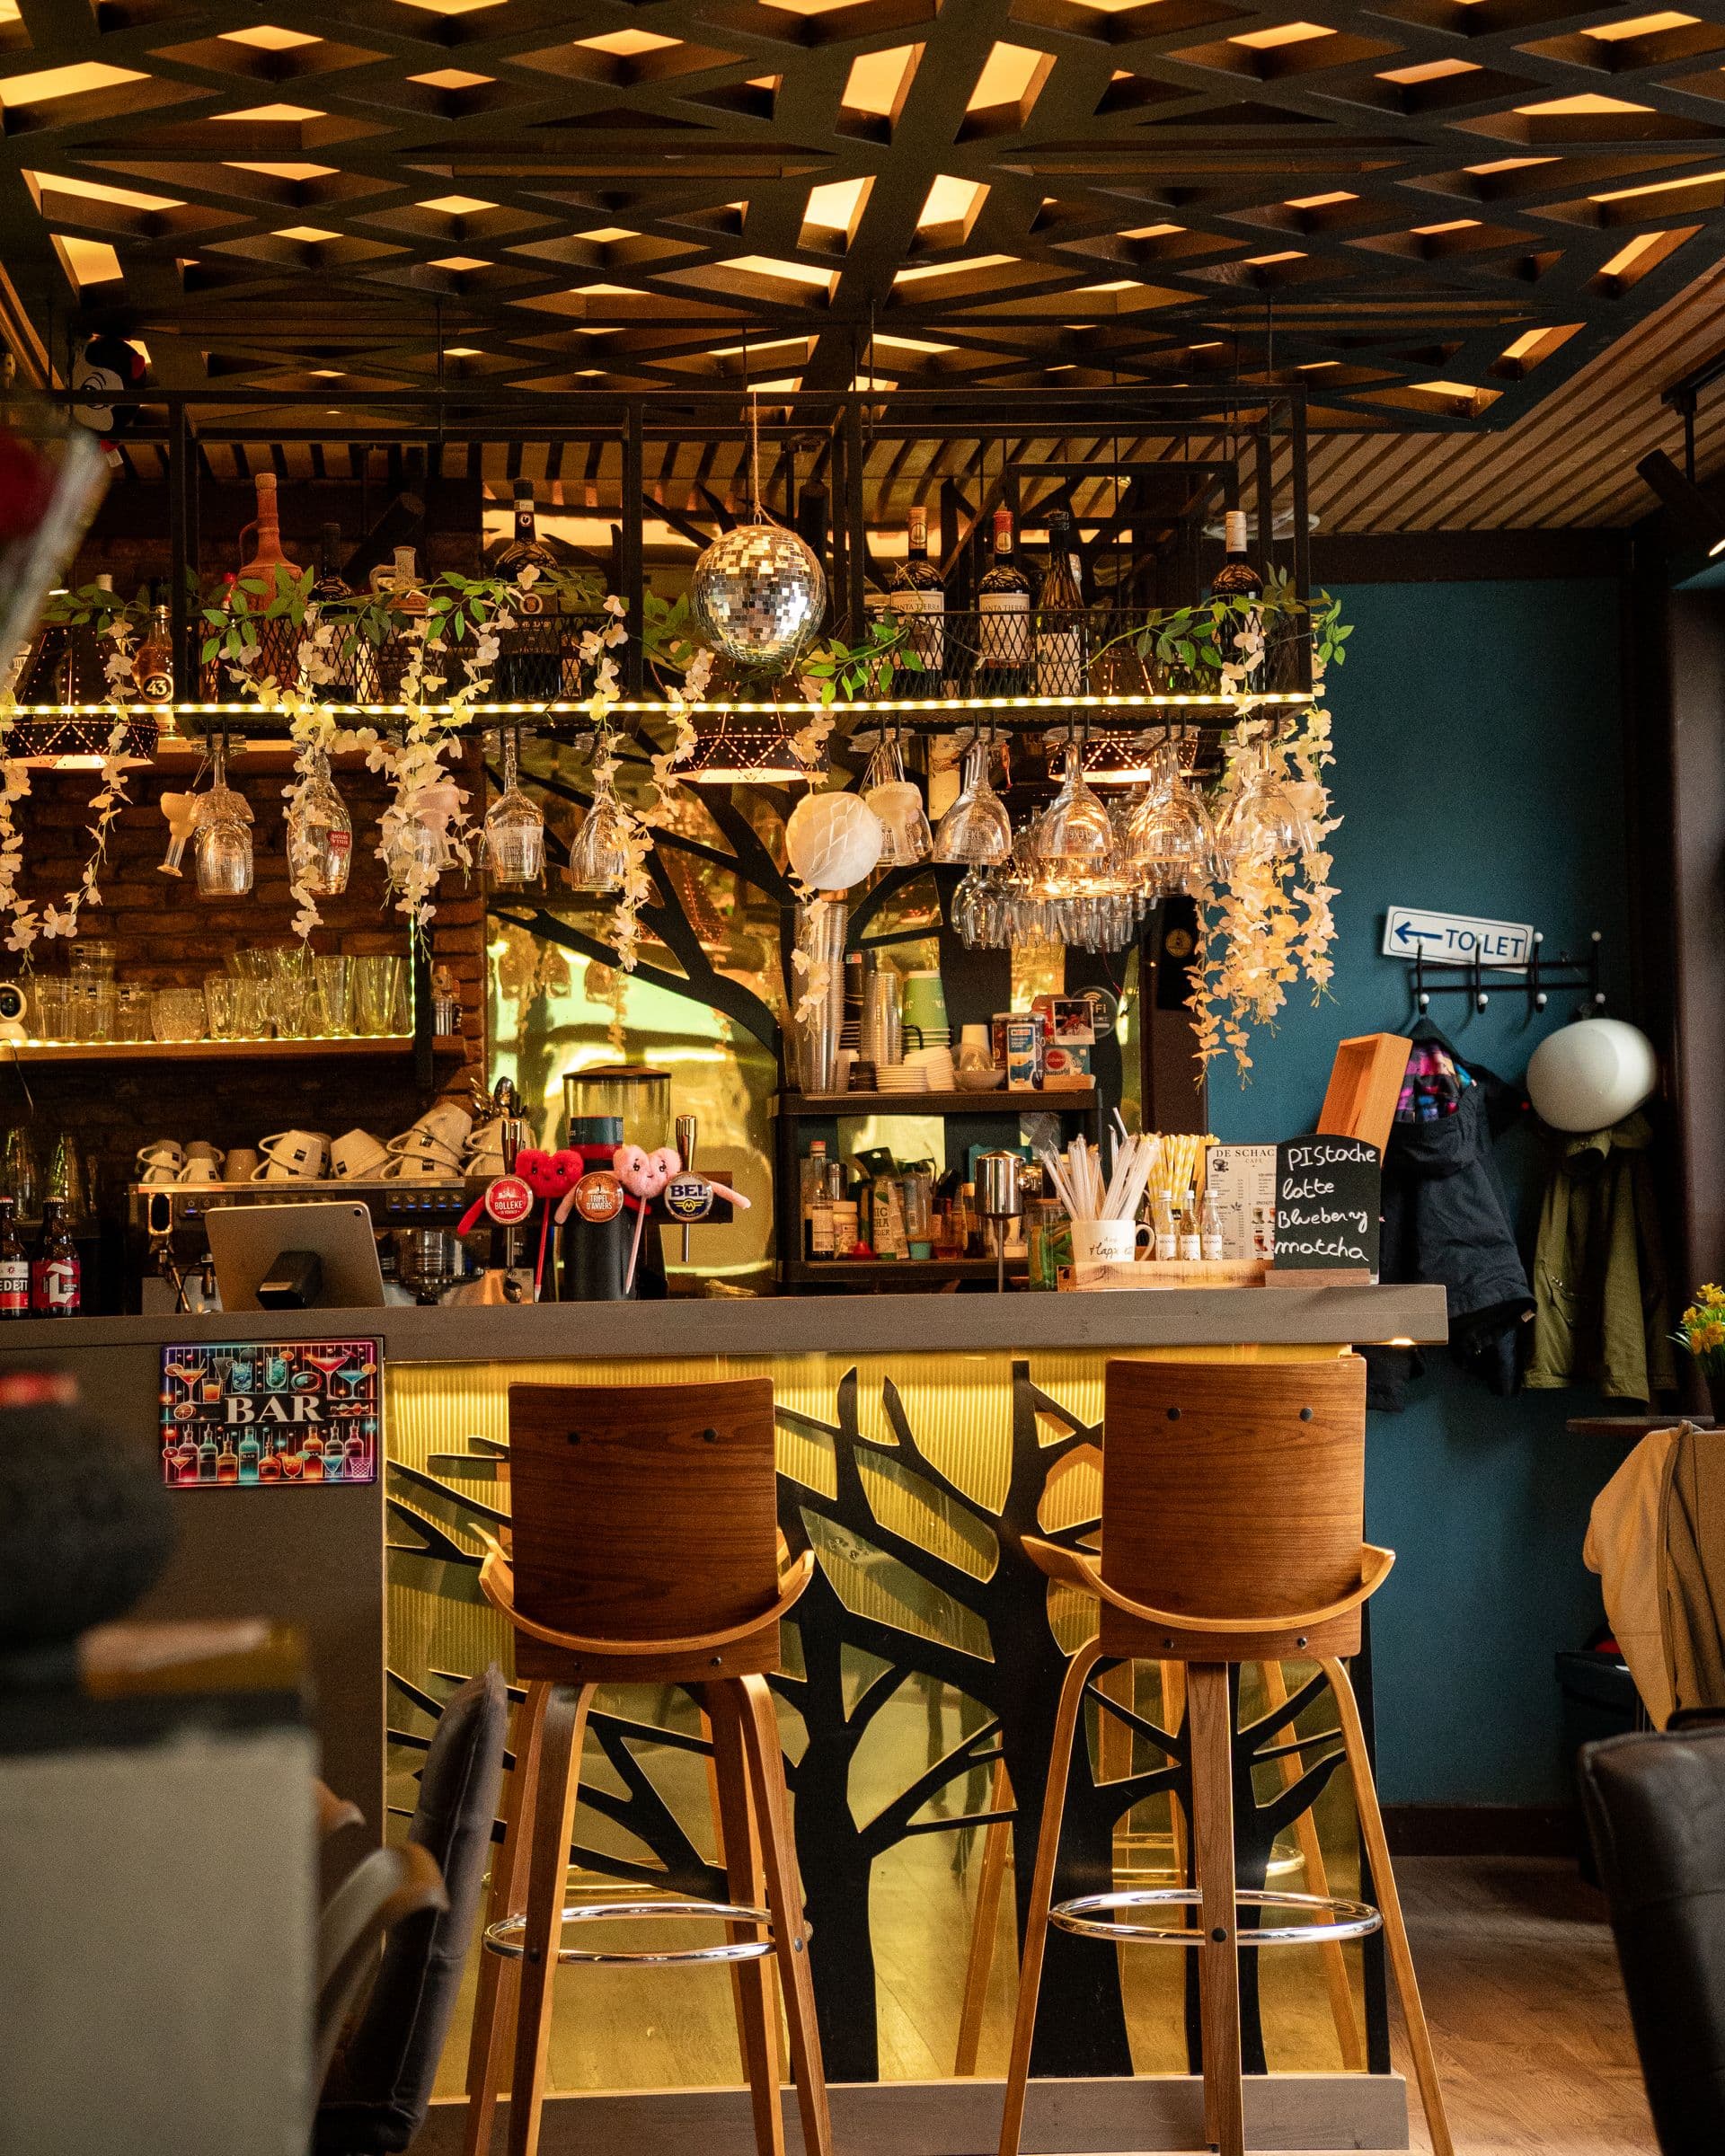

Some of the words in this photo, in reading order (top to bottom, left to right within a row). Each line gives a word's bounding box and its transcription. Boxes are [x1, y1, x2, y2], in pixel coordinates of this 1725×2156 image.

[146, 680, 167, 695] 43
[1446, 929, 1525, 958] TOLET
[670, 1184, 708, 1197] BEL
[494, 1200, 523, 1211] BOLLEKE
[589, 1195, 607, 1203] TRIPEL
[225, 1394, 324, 1425] BAR
